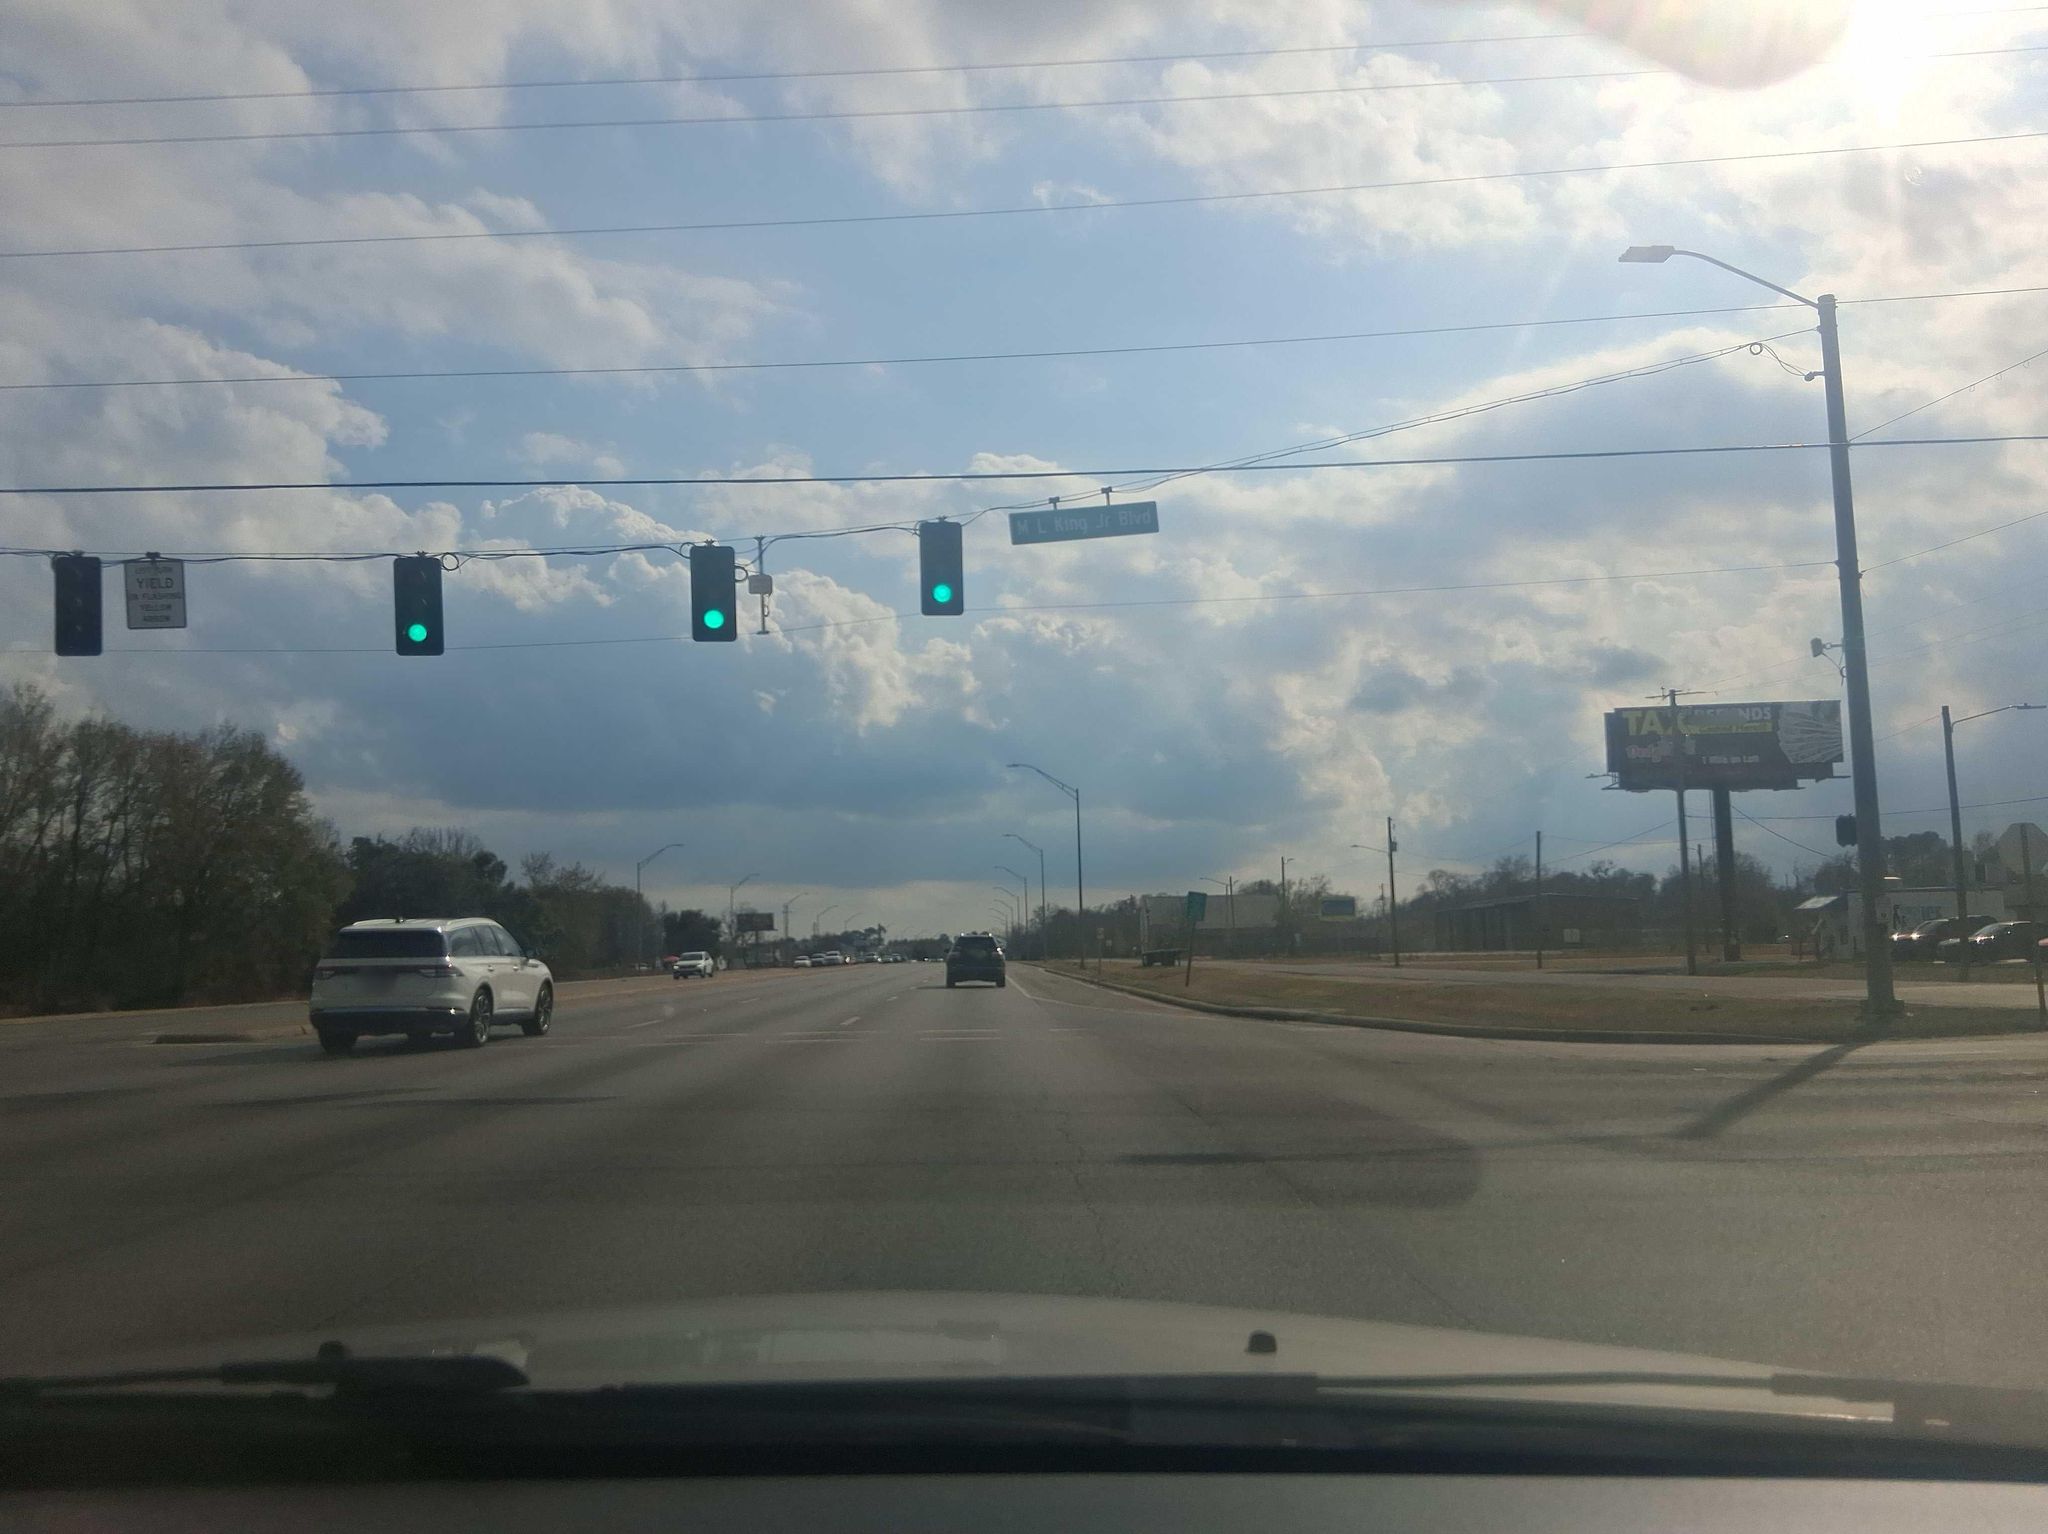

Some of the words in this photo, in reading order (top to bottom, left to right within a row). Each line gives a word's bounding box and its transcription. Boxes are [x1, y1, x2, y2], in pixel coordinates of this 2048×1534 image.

[1016, 519, 1029, 535] M
[1037, 518, 1047, 534] L
[1053, 515, 1088, 535] King
[1096, 513, 1112, 529] Jr
[1118, 508, 1152, 527] Blvd
[136, 577, 174, 589] YIELD
